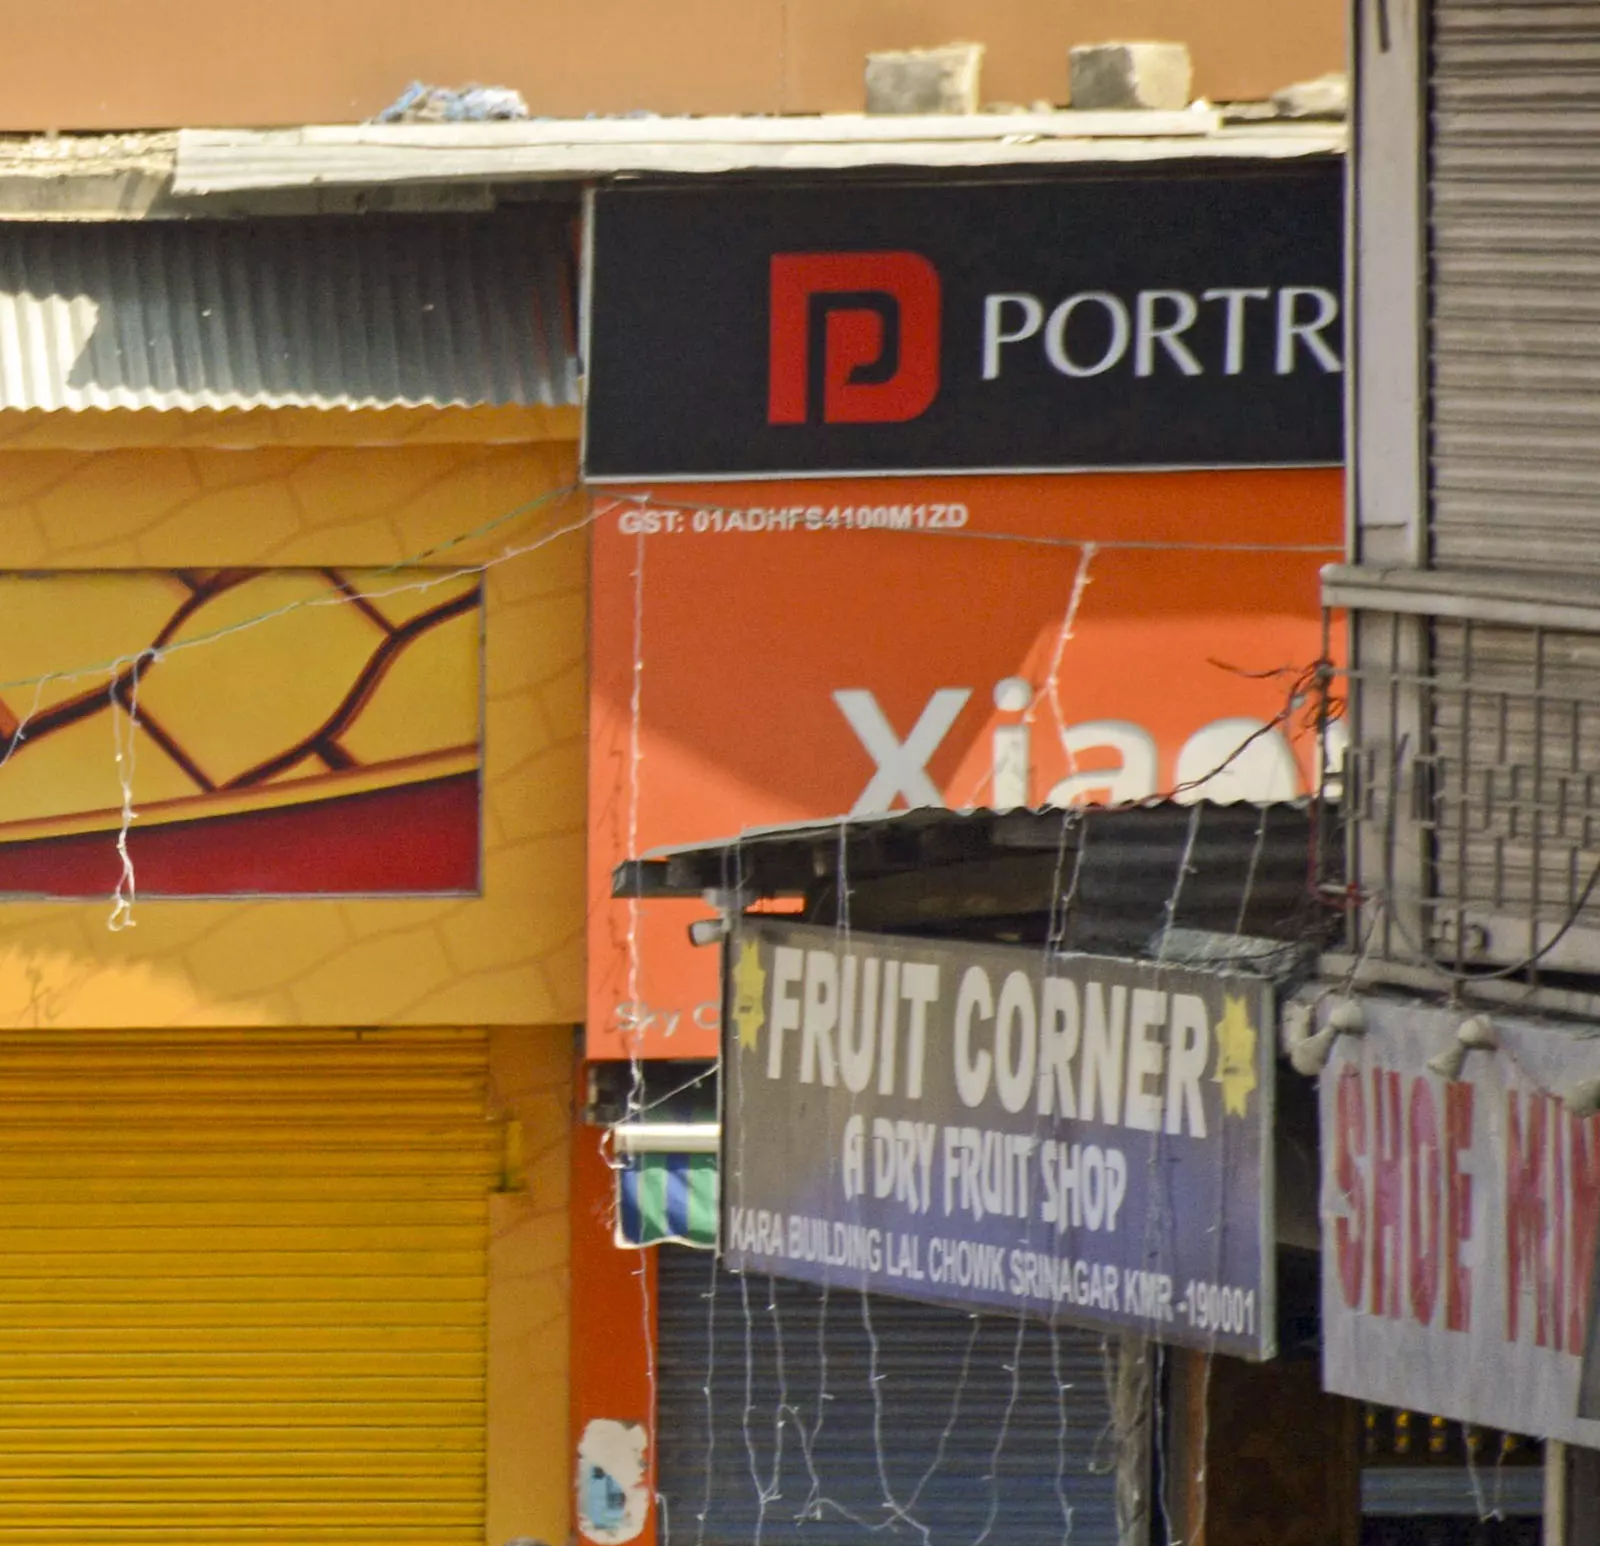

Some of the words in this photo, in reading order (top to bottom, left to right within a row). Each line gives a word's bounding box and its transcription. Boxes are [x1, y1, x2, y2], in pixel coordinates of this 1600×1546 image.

[618, 511, 686, 534] GST:
[767, 947, 939, 1100] FRUIT
[954, 966, 1210, 1138] CORNER
[873, 1117, 936, 1215] DRY
[943, 1125, 1037, 1222] FRUIT
[1041, 1137, 1127, 1234] SHOP
[1336, 1062, 1474, 1333] SHOE
[729, 1206, 783, 1257] KARA
[788, 1214, 881, 1273] BUILDING
[886, 1232, 925, 1280] LAL
[927, 1237, 1006, 1292] CHOWK
[1009, 1249, 1119, 1312] SRINAGAR
